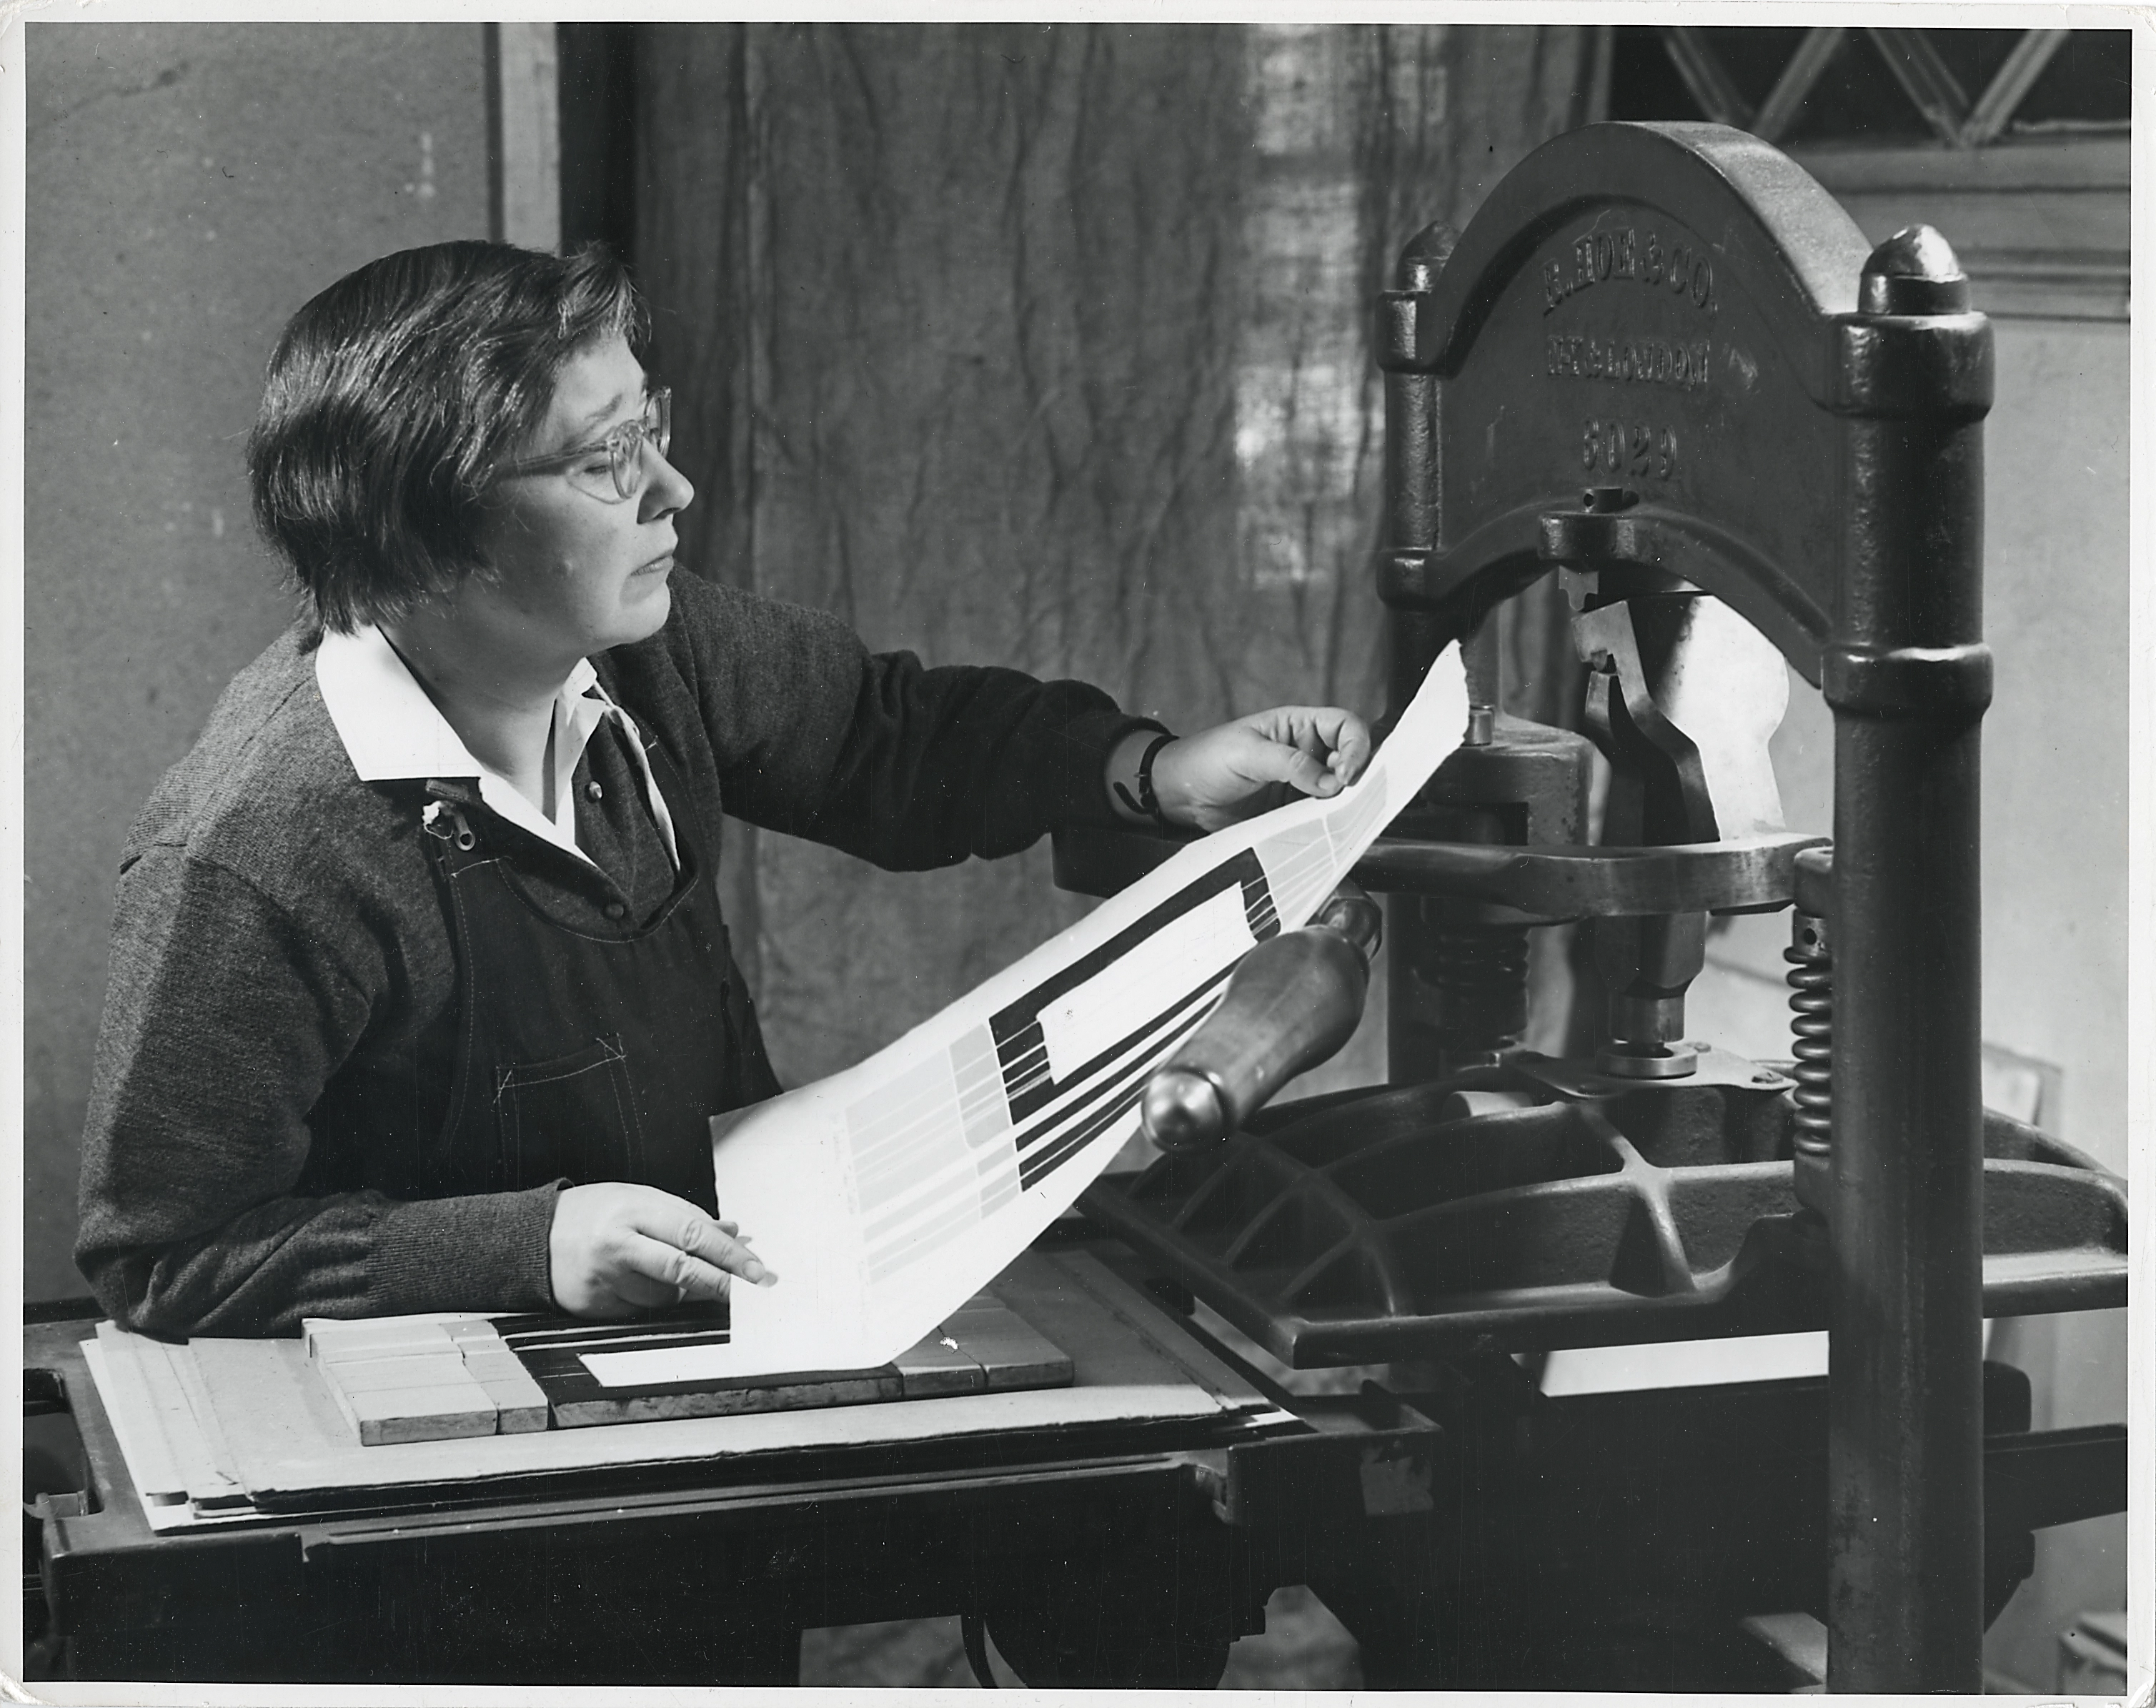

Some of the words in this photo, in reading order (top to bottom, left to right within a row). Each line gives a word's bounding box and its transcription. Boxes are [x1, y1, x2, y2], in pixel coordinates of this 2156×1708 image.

[1643, 231, 1664, 286] &
[1604, 339, 1710, 392] LONDON
[1583, 419, 1677, 480] 6029
